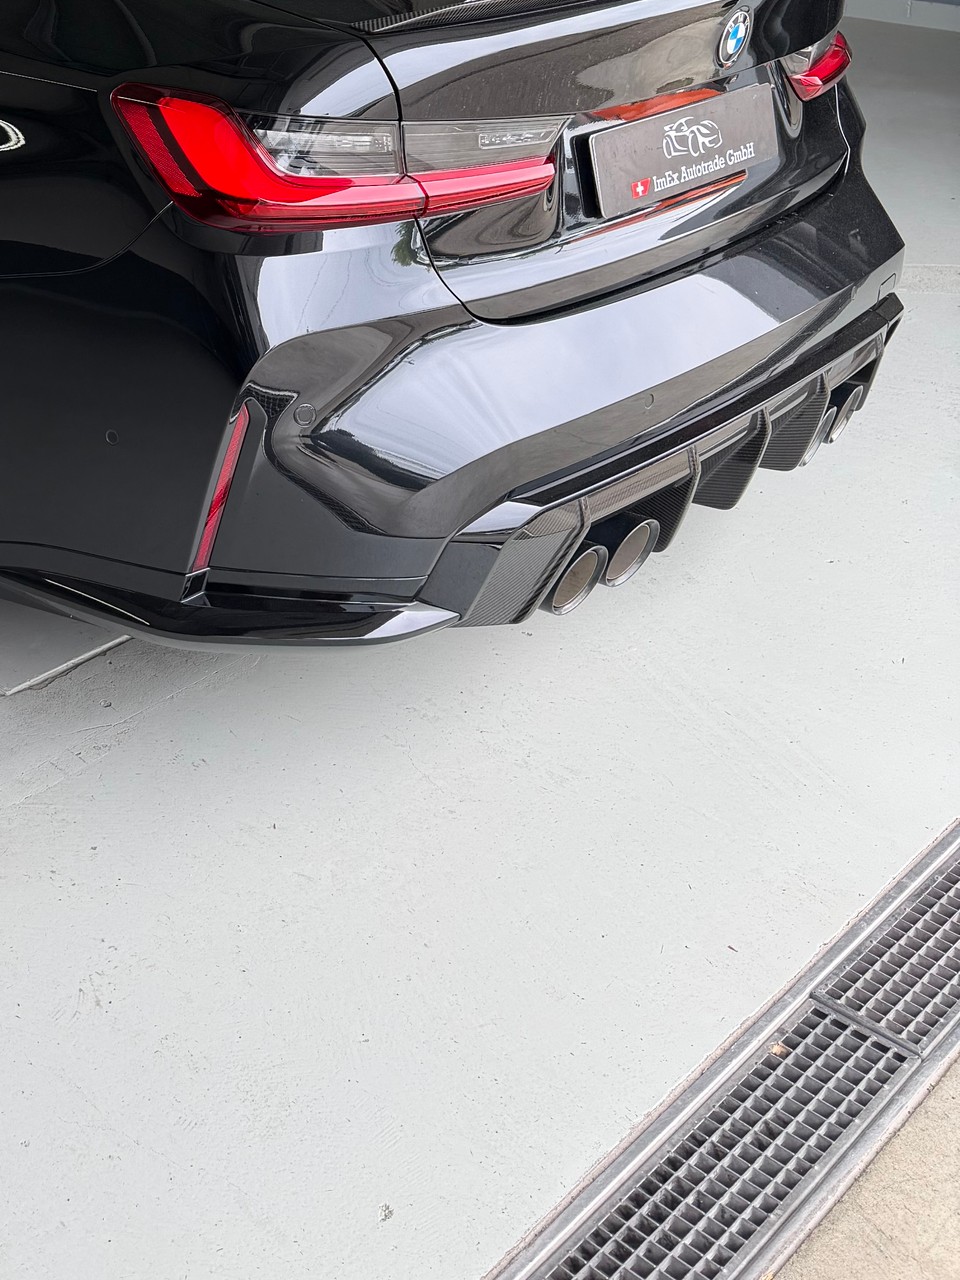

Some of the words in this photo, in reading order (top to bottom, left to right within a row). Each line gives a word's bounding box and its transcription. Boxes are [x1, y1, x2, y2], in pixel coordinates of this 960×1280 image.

[653, 170, 680, 192] ImEx
[680, 155, 726, 183] Autotrade
[726, 142, 755, 166] GmbH
